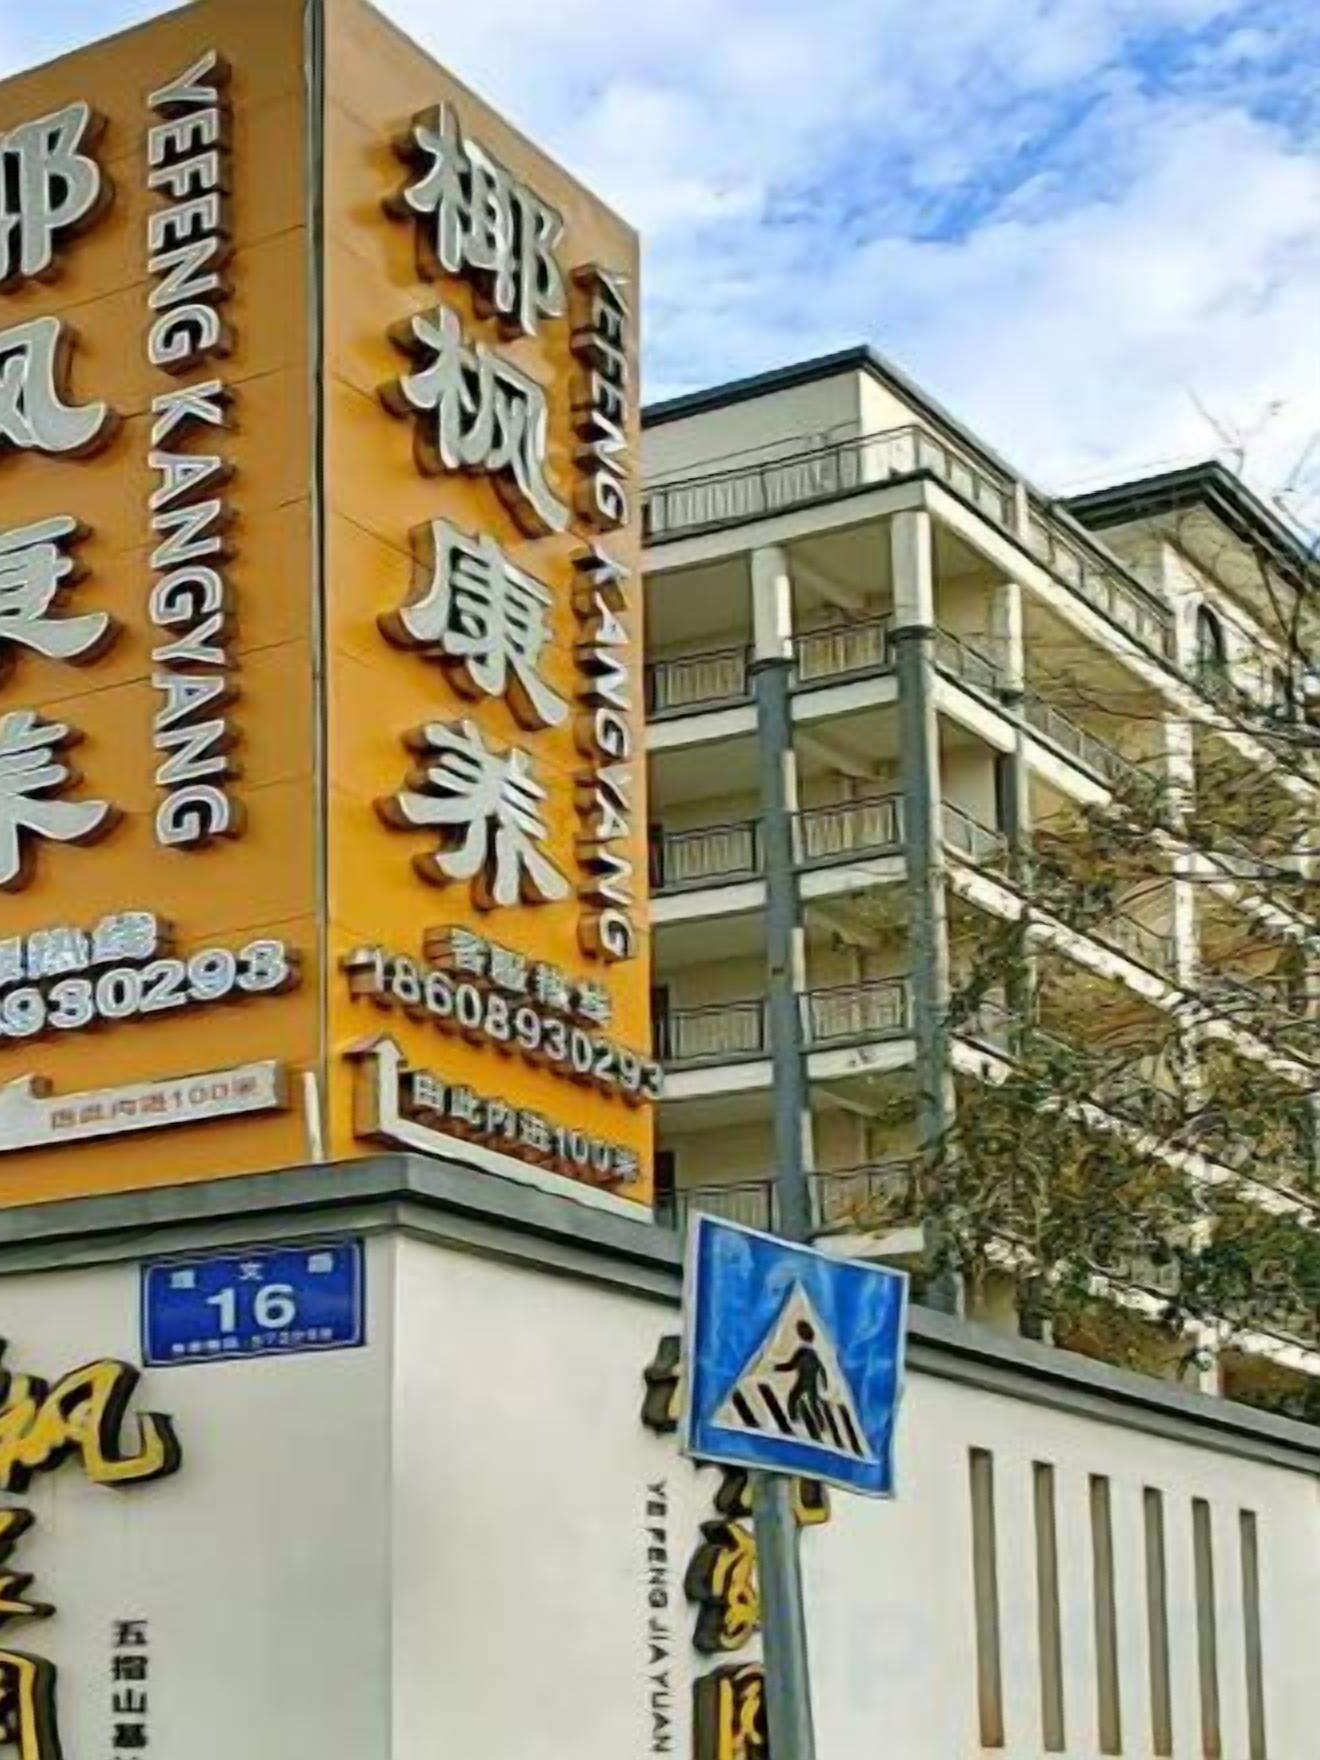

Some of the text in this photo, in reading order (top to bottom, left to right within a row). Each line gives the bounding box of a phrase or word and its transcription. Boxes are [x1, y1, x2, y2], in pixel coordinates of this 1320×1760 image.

[147, 50, 229, 847] YEFENG KANGYANG
[398, 102, 570, 907] 椰枫康养
[590, 267, 634, 961] YEFENG KANGYANG
[348, 946, 665, 1100] 18608930293
[206, 1283, 297, 1333] 16
[113, 1620, 148, 1760] 五指山基
